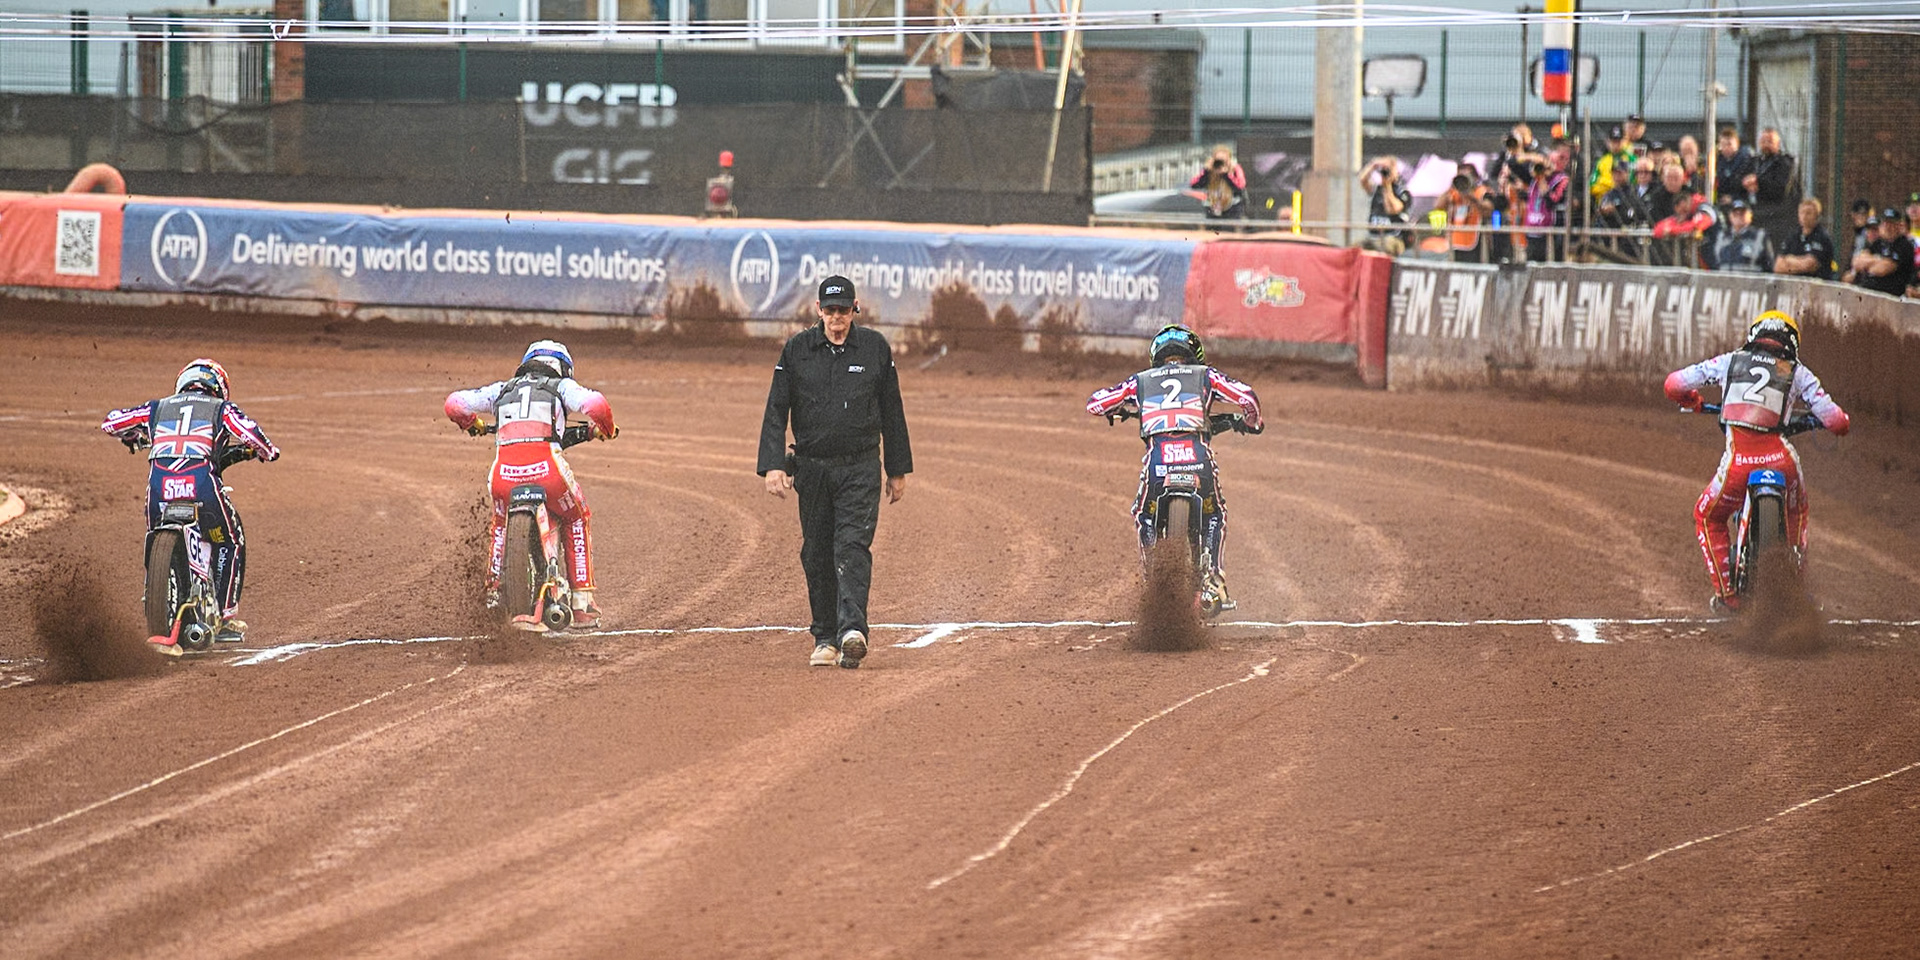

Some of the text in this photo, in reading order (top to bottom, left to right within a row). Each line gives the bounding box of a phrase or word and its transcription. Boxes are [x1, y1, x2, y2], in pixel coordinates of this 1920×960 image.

[521, 81, 678, 127] UCFB
[161, 234, 199, 260] ATPI
[232, 233, 667, 282] Delivering world class travel solutions
[799, 254, 1160, 302] Delivering world class travel solutions
[1751, 354, 1776, 365] POLAND
[1159, 378, 1182, 410] 2
[1743, 366, 1771, 402] 2
[517, 385, 532, 419] 1
[179, 405, 194, 436] 1
[1164, 443, 1195, 463] STAR
[164, 479, 195, 499] STAR
